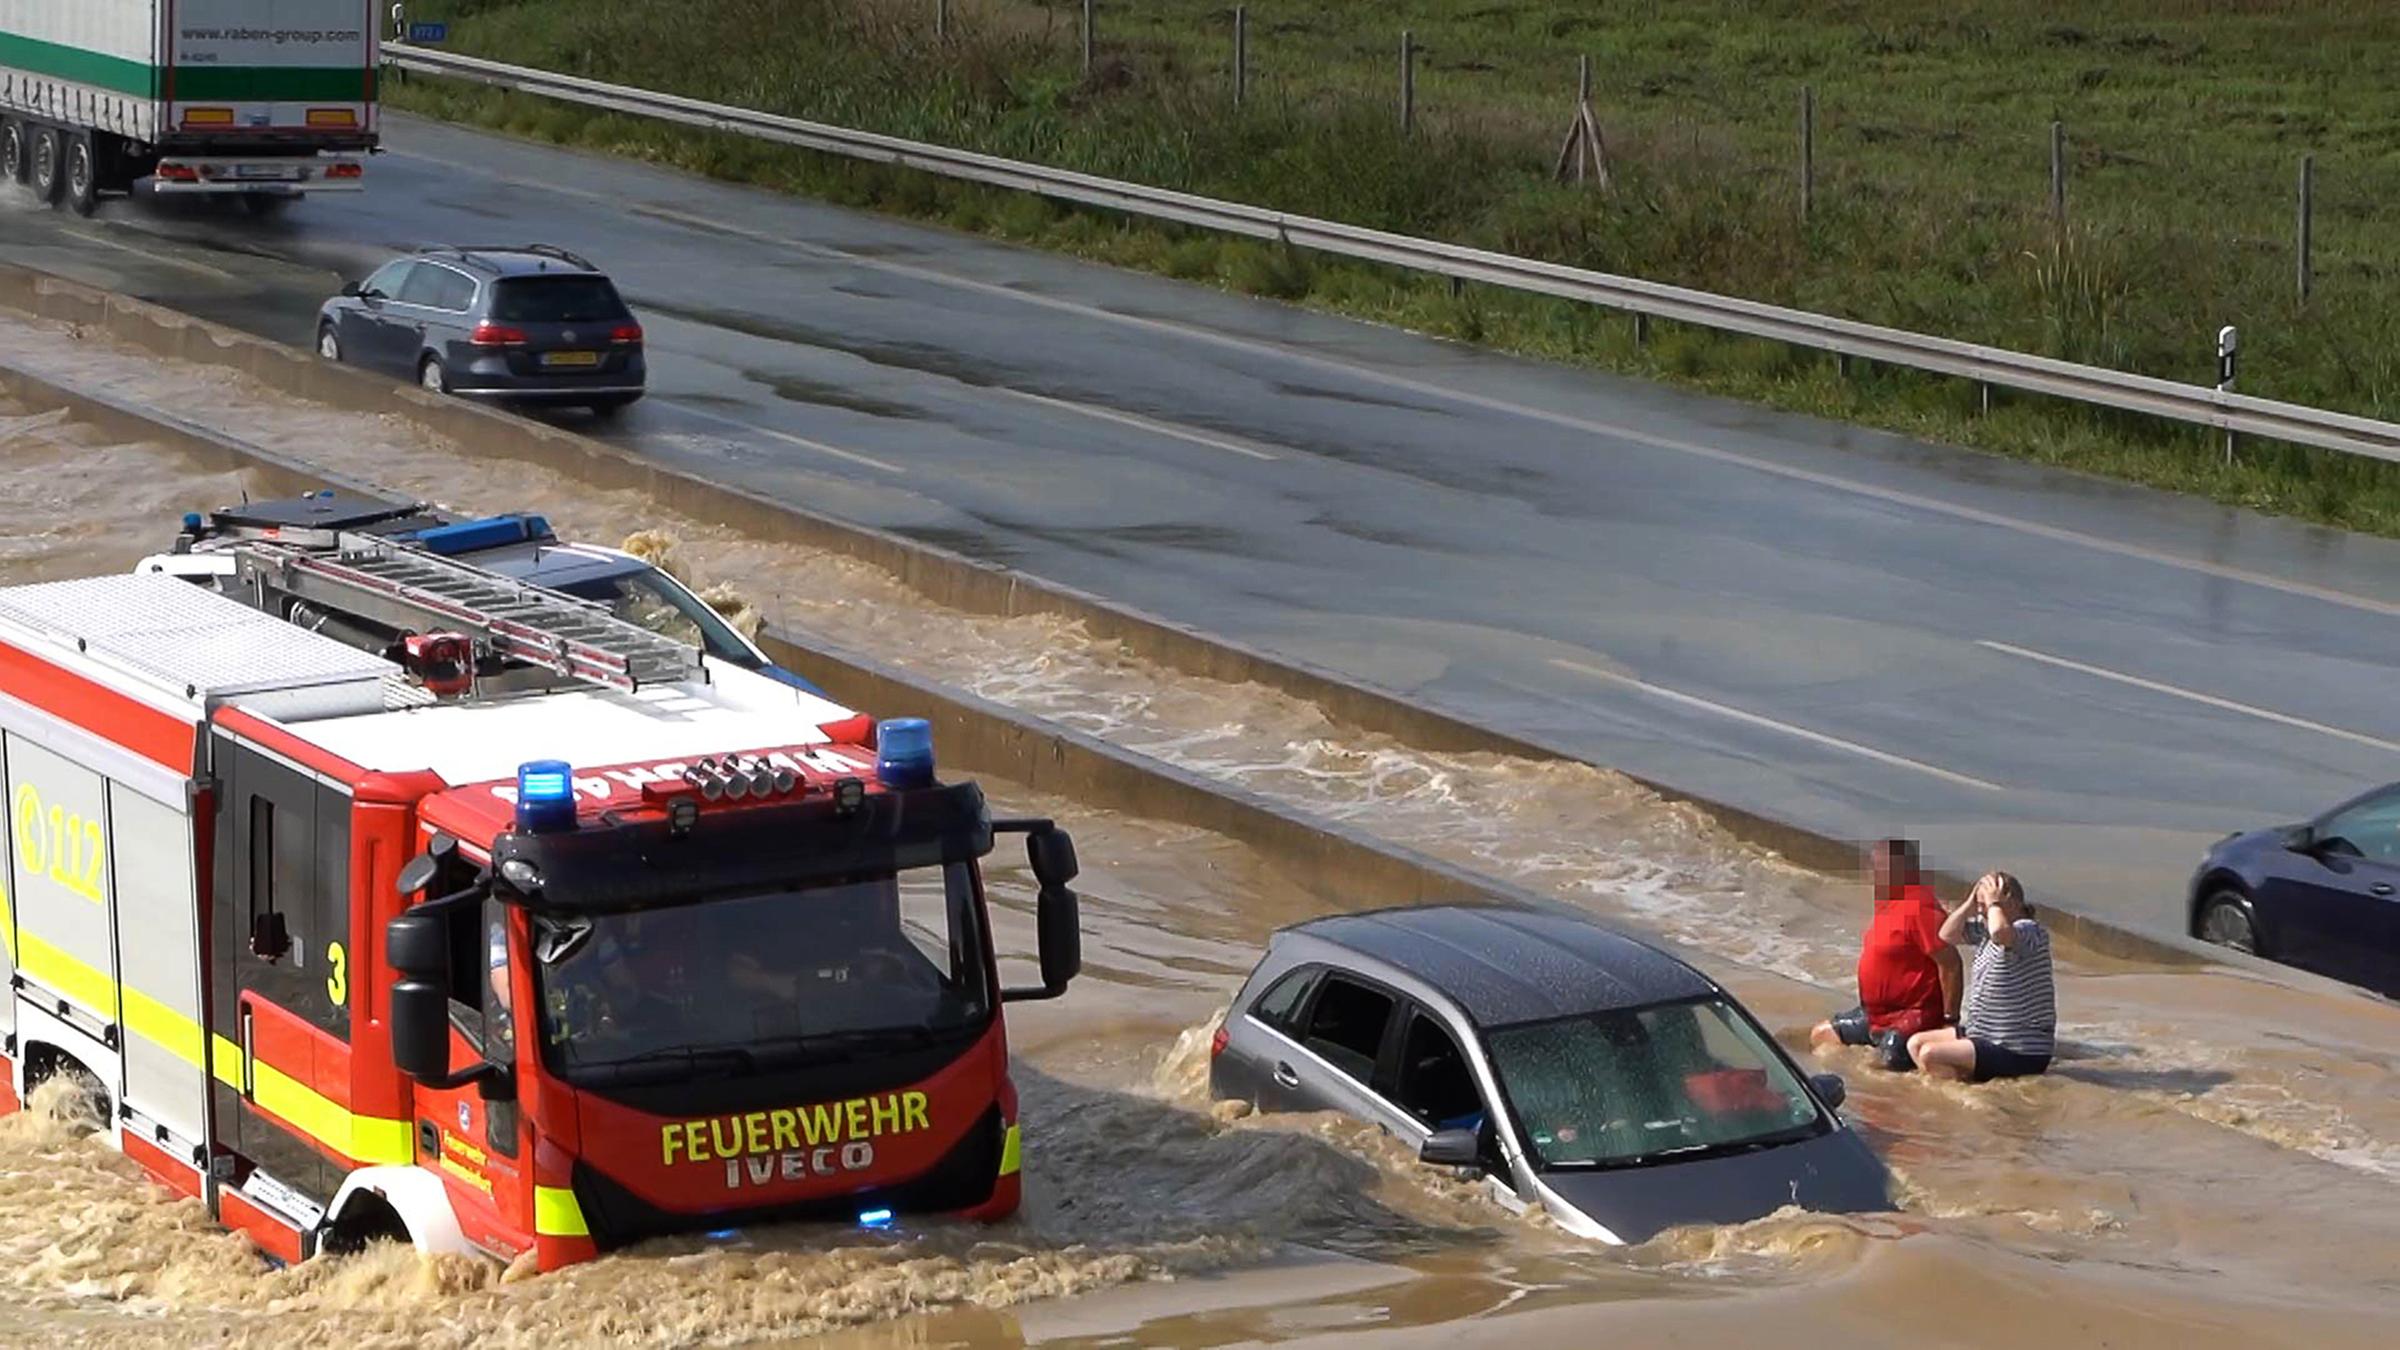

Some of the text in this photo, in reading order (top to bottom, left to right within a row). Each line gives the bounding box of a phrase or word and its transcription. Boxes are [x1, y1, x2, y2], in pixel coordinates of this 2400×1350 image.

[181, 27, 361, 44] www.raben-group.com
[49, 804, 103, 904] 112
[327, 941, 346, 1006] 3
[662, 1091, 930, 1165] FEUERWEHR
[726, 1141, 873, 1188] IVECO
